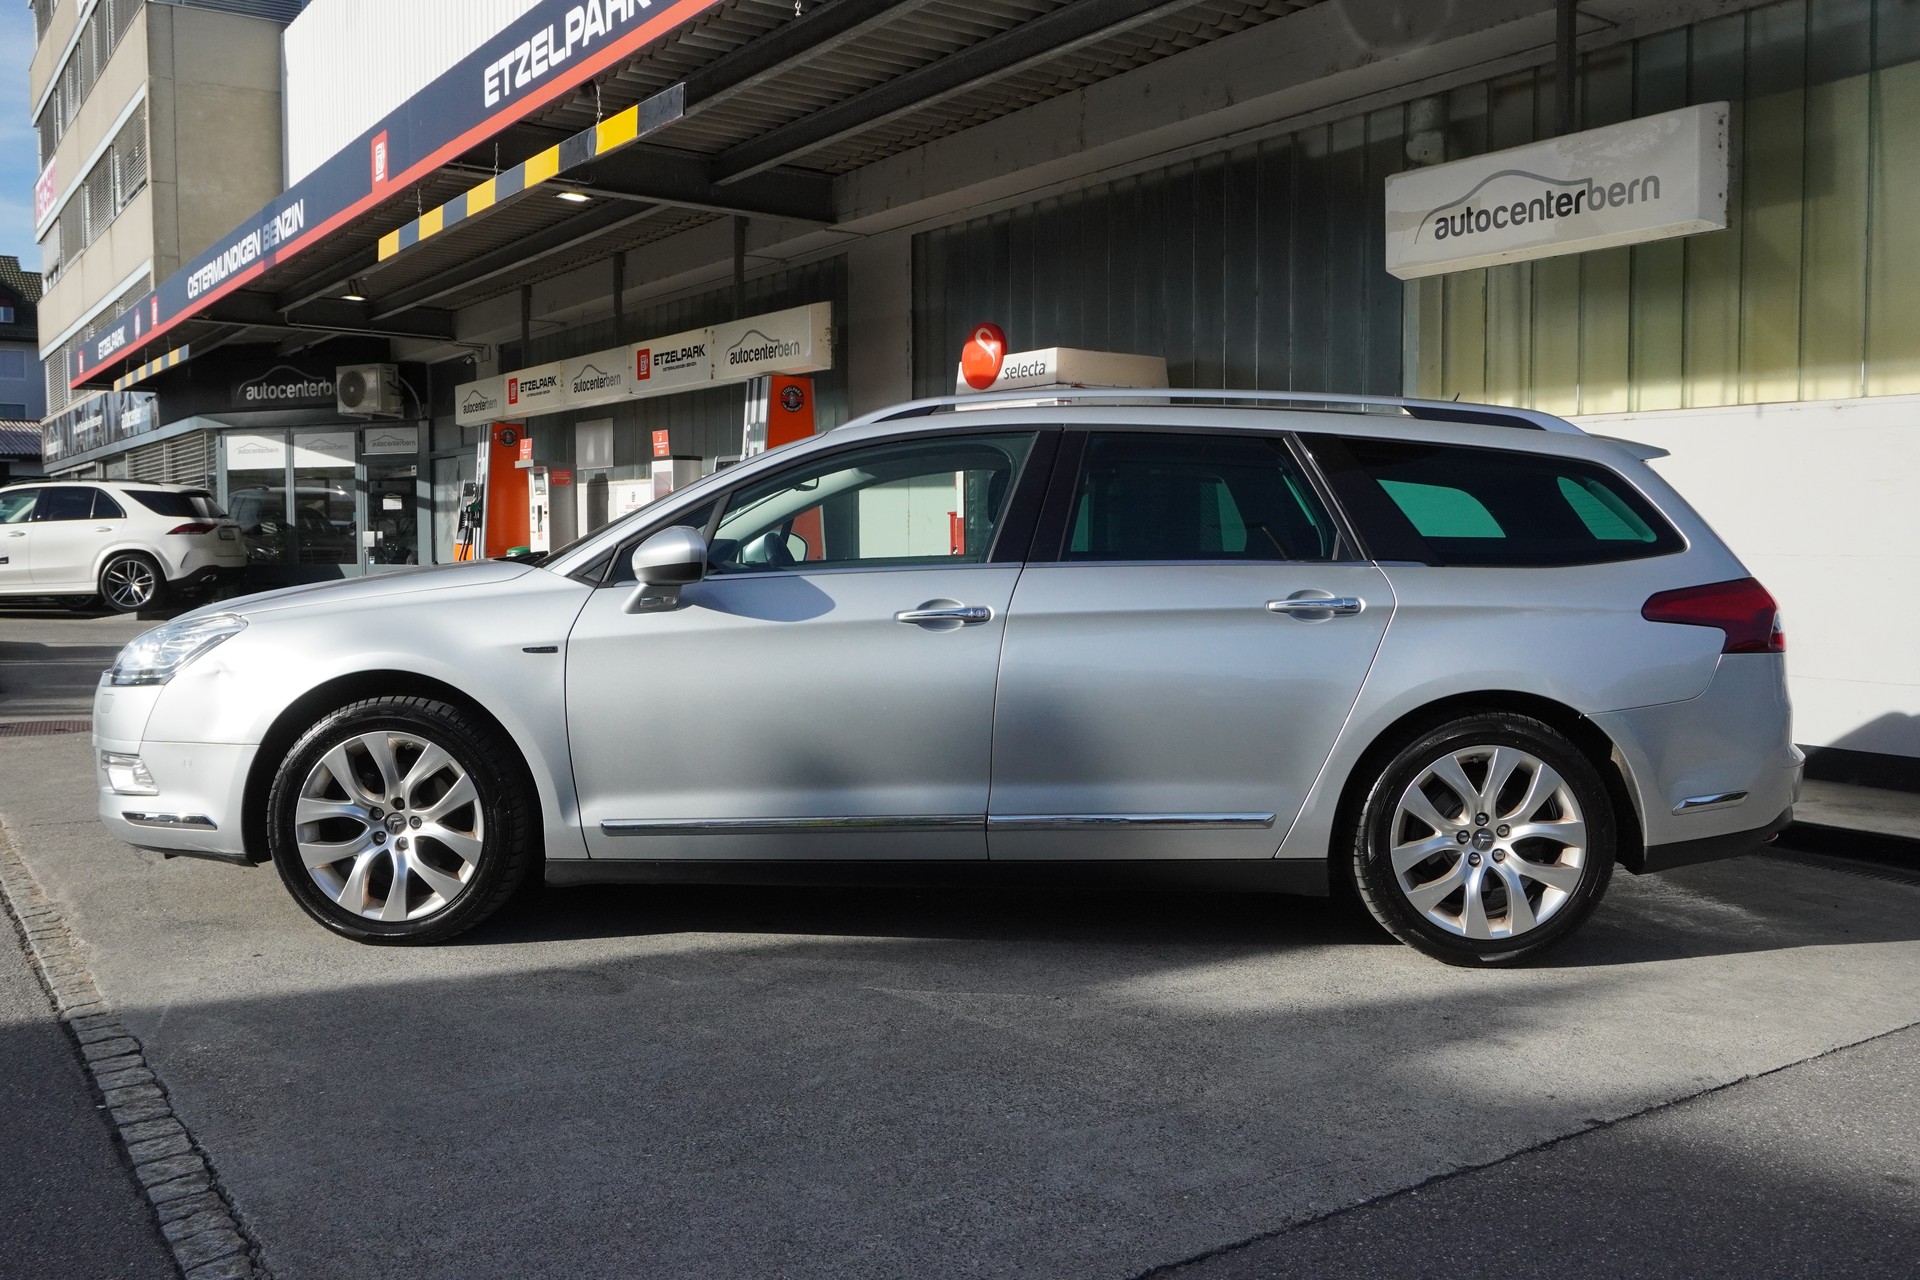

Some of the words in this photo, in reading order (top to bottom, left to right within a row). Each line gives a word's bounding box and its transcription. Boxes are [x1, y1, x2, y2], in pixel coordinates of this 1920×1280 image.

[484, 0, 652, 108] ETZELPAR
[1434, 175, 1661, 240] autocenterbern
[187, 228, 261, 299] OSTERMUNDIGEN
[263, 198, 304, 251] BENZIN
[653, 344, 706, 367] ETZELPARK
[729, 340, 800, 365] autocenterbern
[1003, 360, 1046, 380] selecta
[520, 375, 557, 393] ETZELPARK
[573, 374, 621, 393] autocenterbern
[371, 438, 416, 448] autocenterbern
